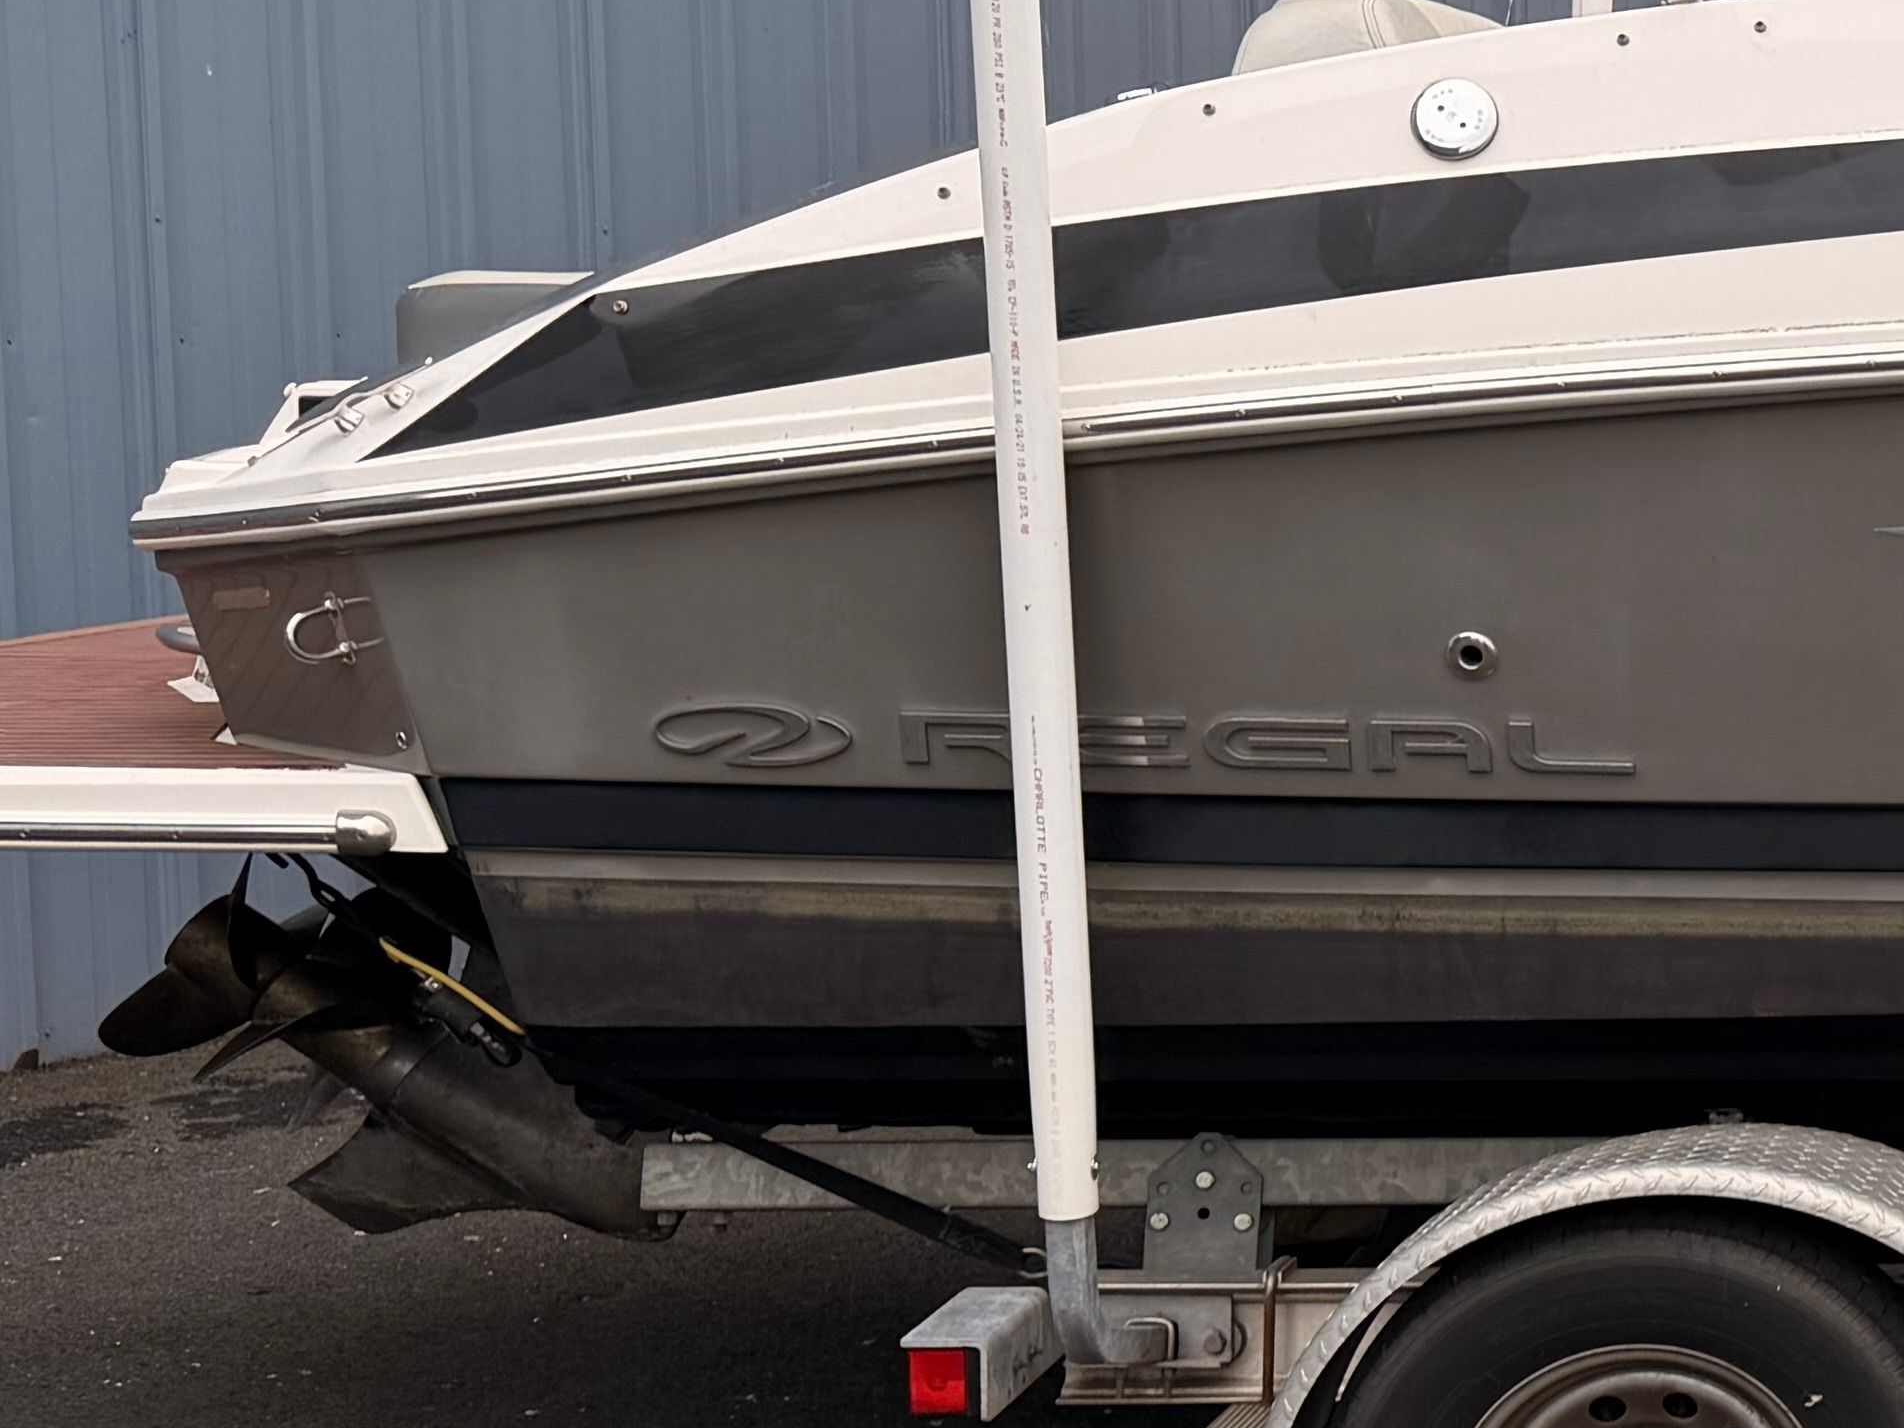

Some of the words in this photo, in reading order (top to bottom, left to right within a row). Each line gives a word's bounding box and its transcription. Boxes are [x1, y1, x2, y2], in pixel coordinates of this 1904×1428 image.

[899, 709, 1637, 775] REGAL
[1032, 767, 1047, 853] CHARLOTTE
[1038, 861, 1050, 900] PIPE
